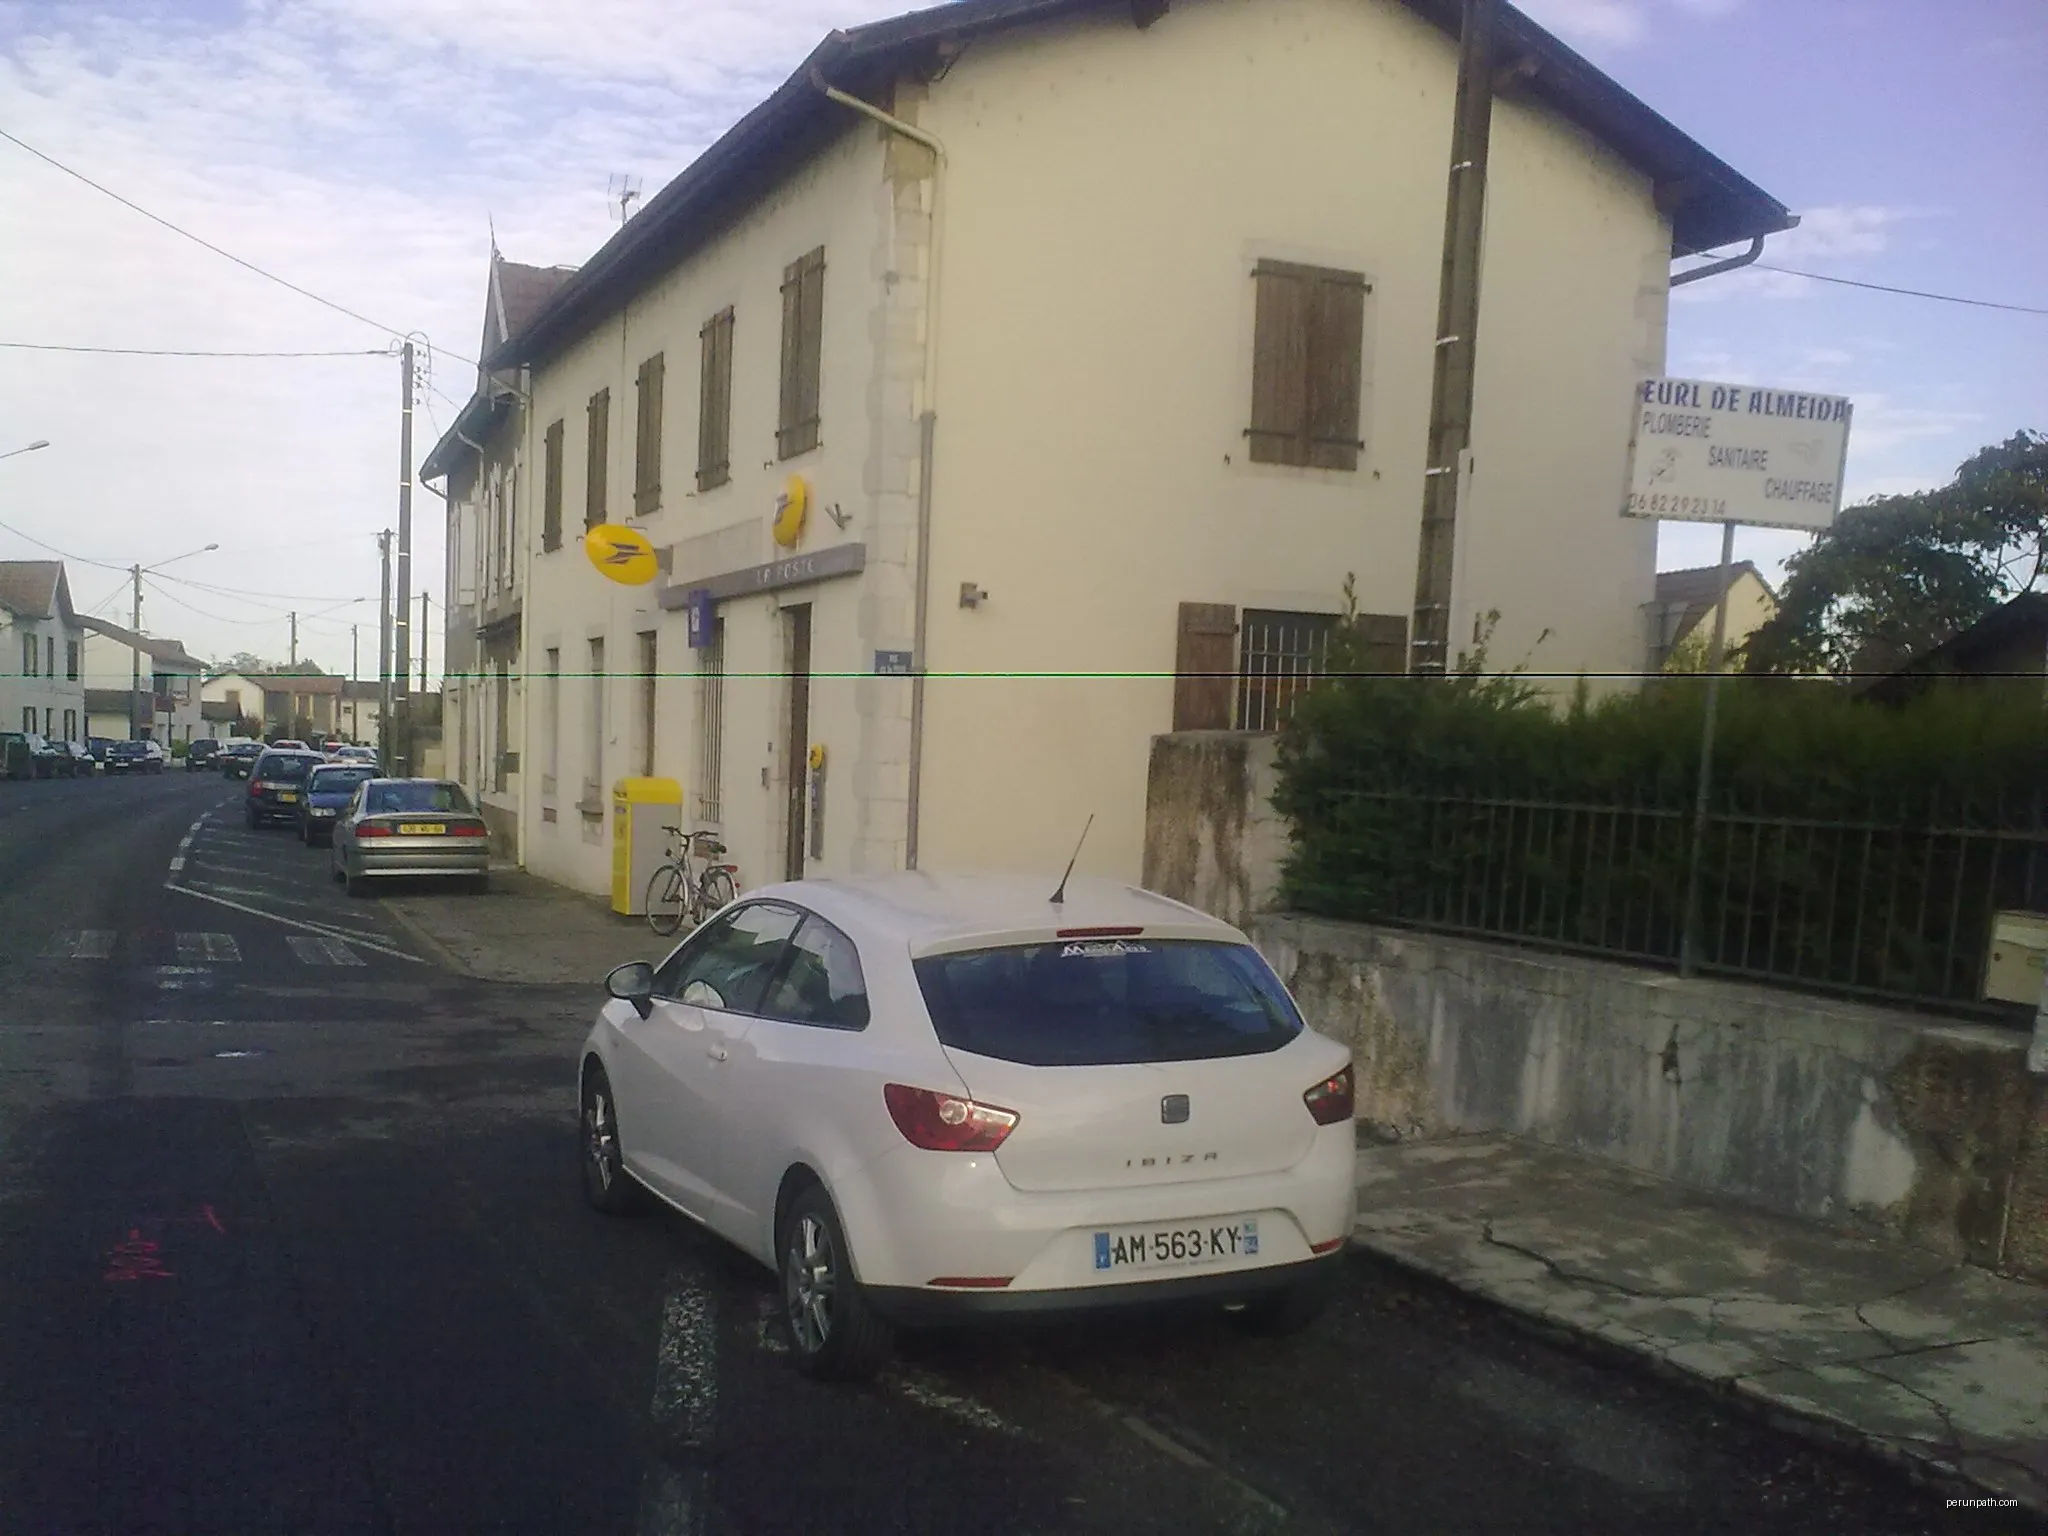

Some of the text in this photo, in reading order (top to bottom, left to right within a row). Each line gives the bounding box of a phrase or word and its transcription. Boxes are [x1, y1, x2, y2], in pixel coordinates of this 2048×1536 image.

[1643, 380, 1848, 422] EURL DE ALMEIDA
[1643, 411, 1711, 438] PLOMBERIE
[1708, 446, 1769, 471] SANITAIRE
[1764, 478, 1833, 504] CHAUFFAGE
[1126, 1152, 1218, 1167] IBIZA
